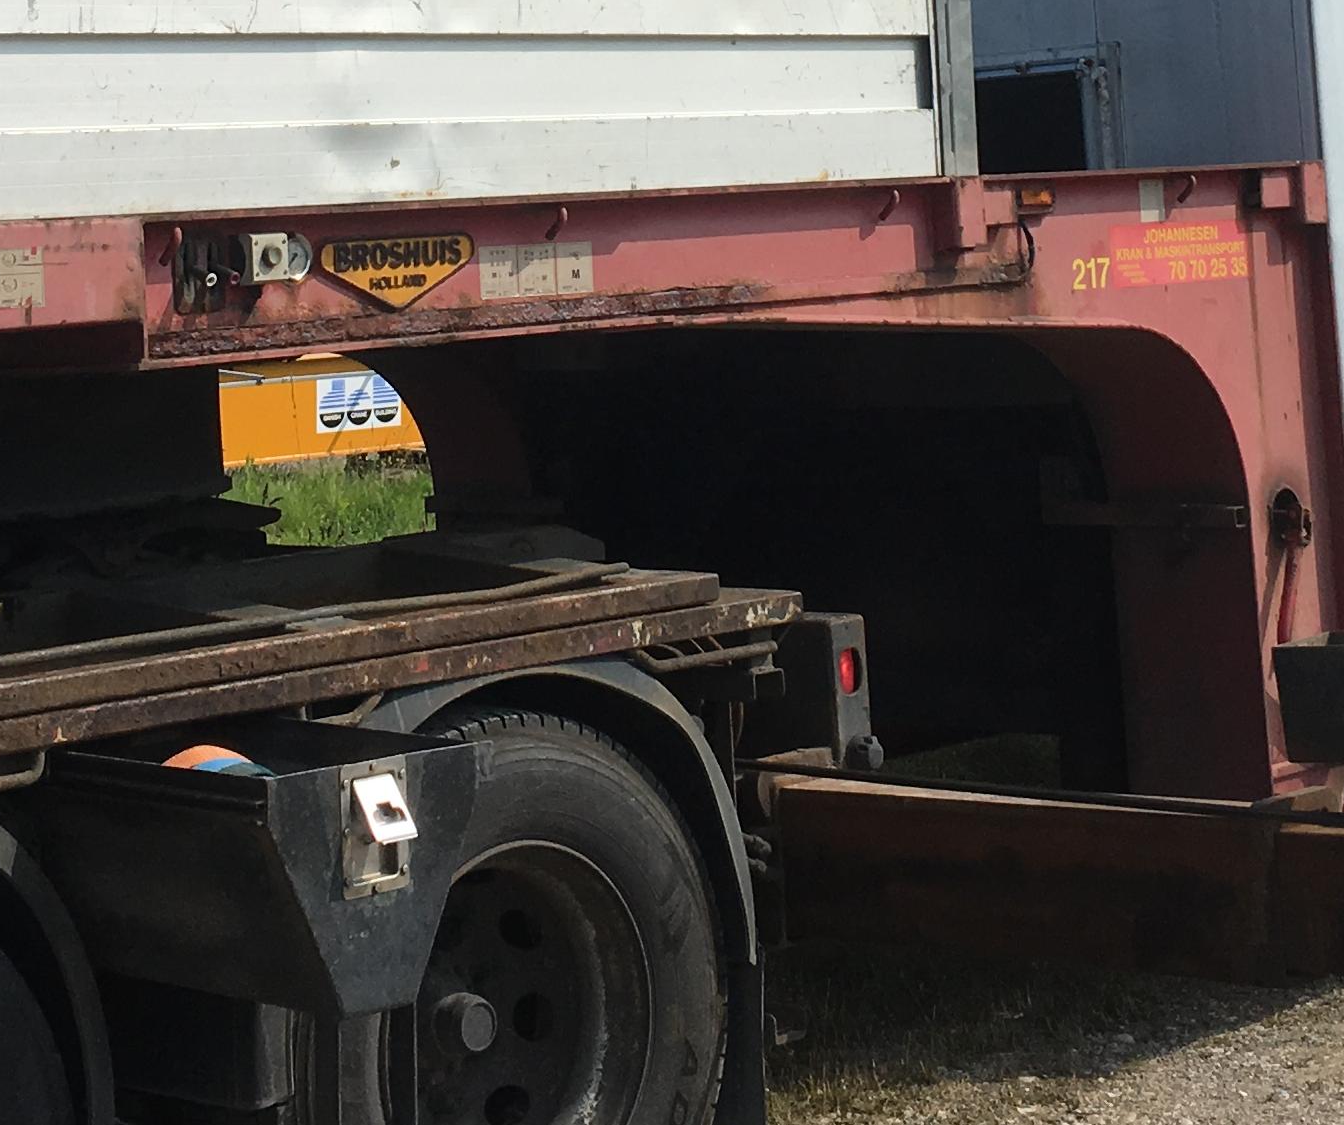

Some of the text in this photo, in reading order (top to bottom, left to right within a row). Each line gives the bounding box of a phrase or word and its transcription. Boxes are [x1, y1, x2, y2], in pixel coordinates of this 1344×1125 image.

[1144, 226, 1218, 244] JOHANNESEN
[333, 238, 463, 273] BROSHUIS
[1116, 247, 1143, 261] KRAN
[1072, 257, 1110, 290] 217
[1168, 260, 1187, 281] 70
[1189, 258, 1207, 279] 70
[1210, 257, 1227, 278] 25
[369, 274, 427, 290] HOLLAND
